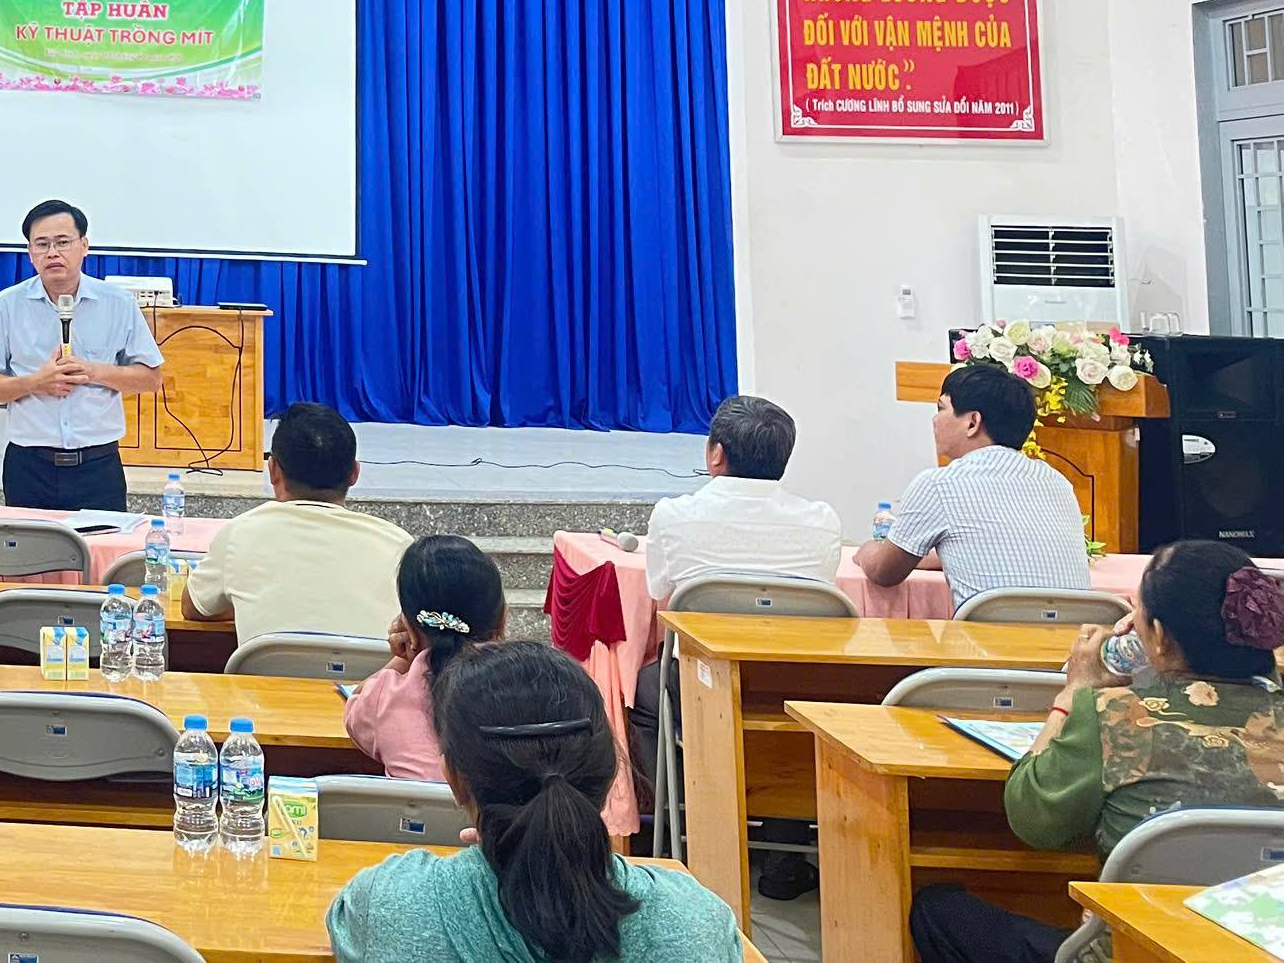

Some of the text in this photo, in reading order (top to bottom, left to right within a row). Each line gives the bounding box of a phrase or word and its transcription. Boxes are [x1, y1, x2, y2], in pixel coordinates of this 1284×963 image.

[63, 0, 102, 19] TẬP
[44, 25, 104, 45] THUẬT
[109, 24, 175, 44] TRỒNG
[181, 30, 214, 45] MÍT
[804, 13, 1011, 51] ĐỐI VỚI VẬN MỆNH CỦA
[807, 57, 841, 89] ĐẤT
[836, 99, 866, 113] CƯƠNG
[907, 100, 931, 113] SUNG
[933, 96, 952, 114] SỬA
[972, 100, 992, 114] NĂM
